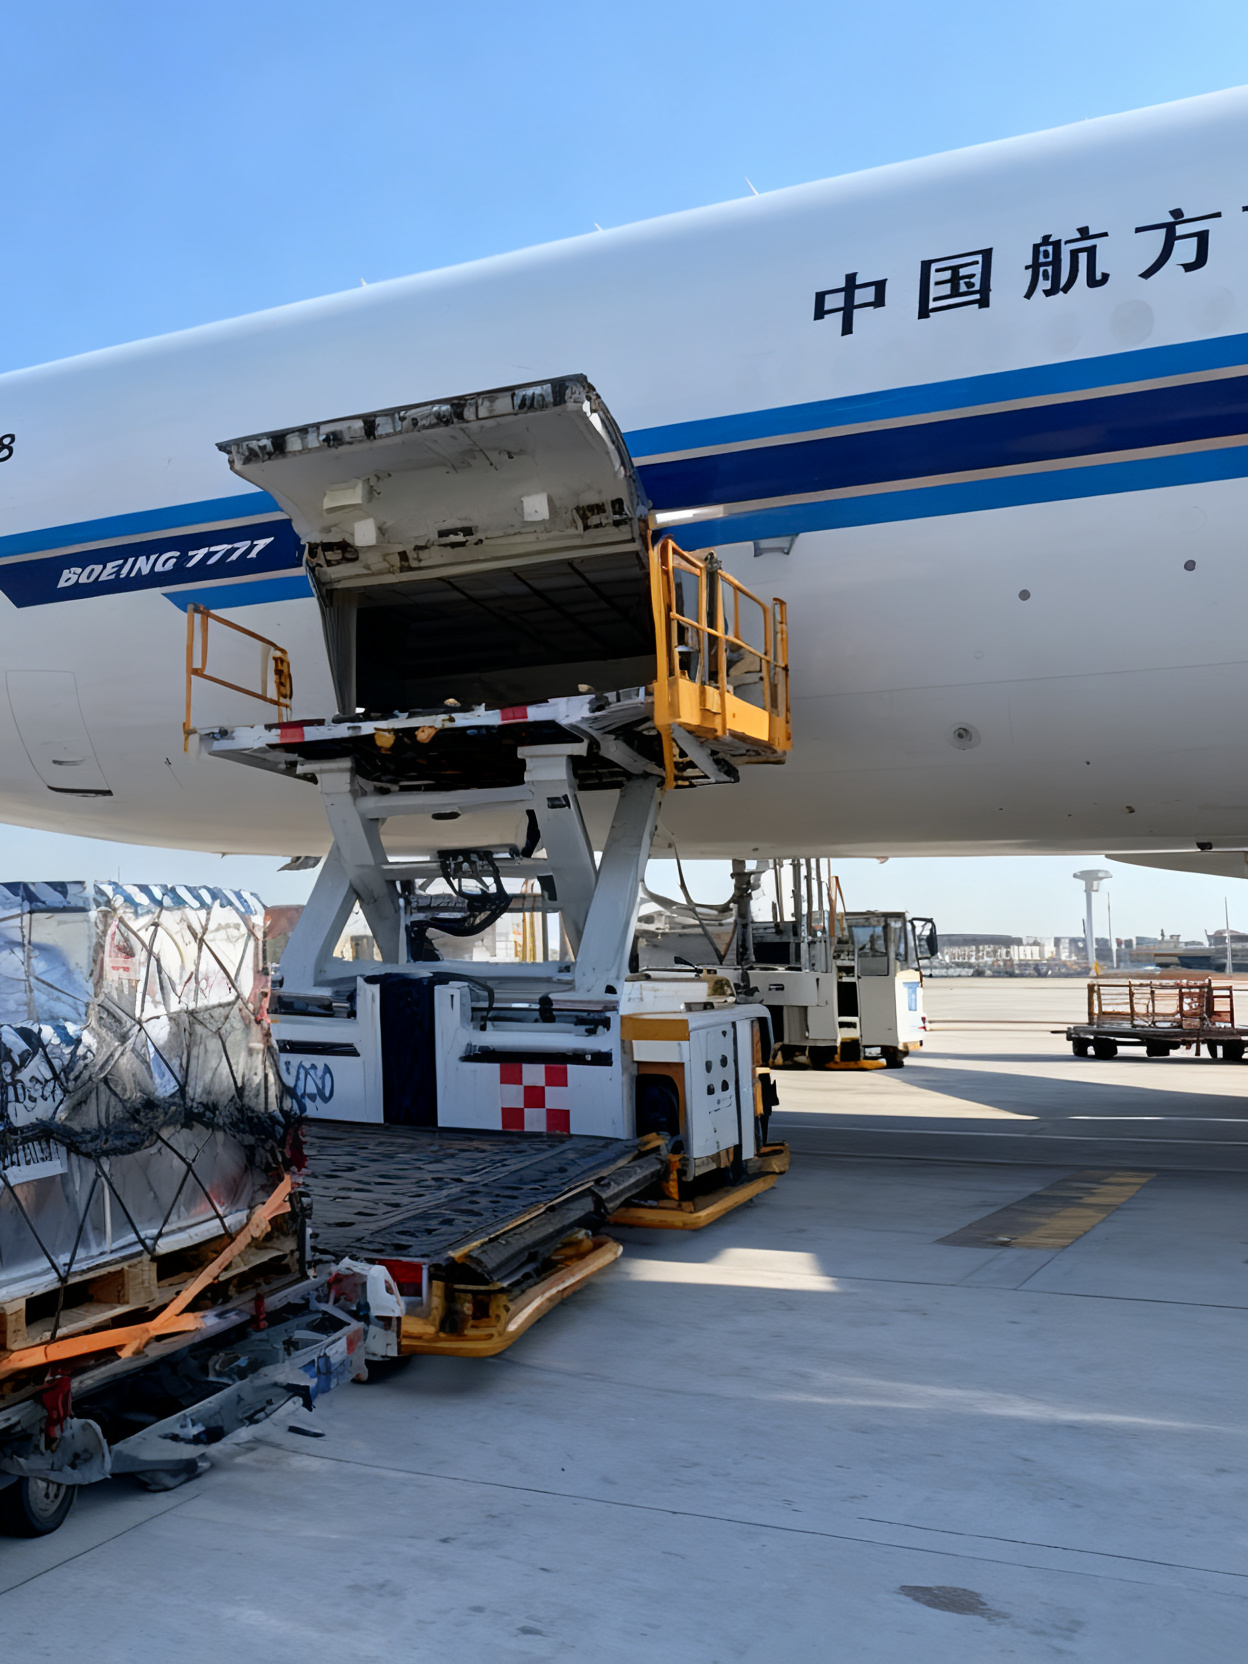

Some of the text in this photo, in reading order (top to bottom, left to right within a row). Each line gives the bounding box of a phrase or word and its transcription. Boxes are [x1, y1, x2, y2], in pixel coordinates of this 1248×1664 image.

[813, 206, 1248, 337] 中国航方
[56, 550, 181, 589] BOEING
